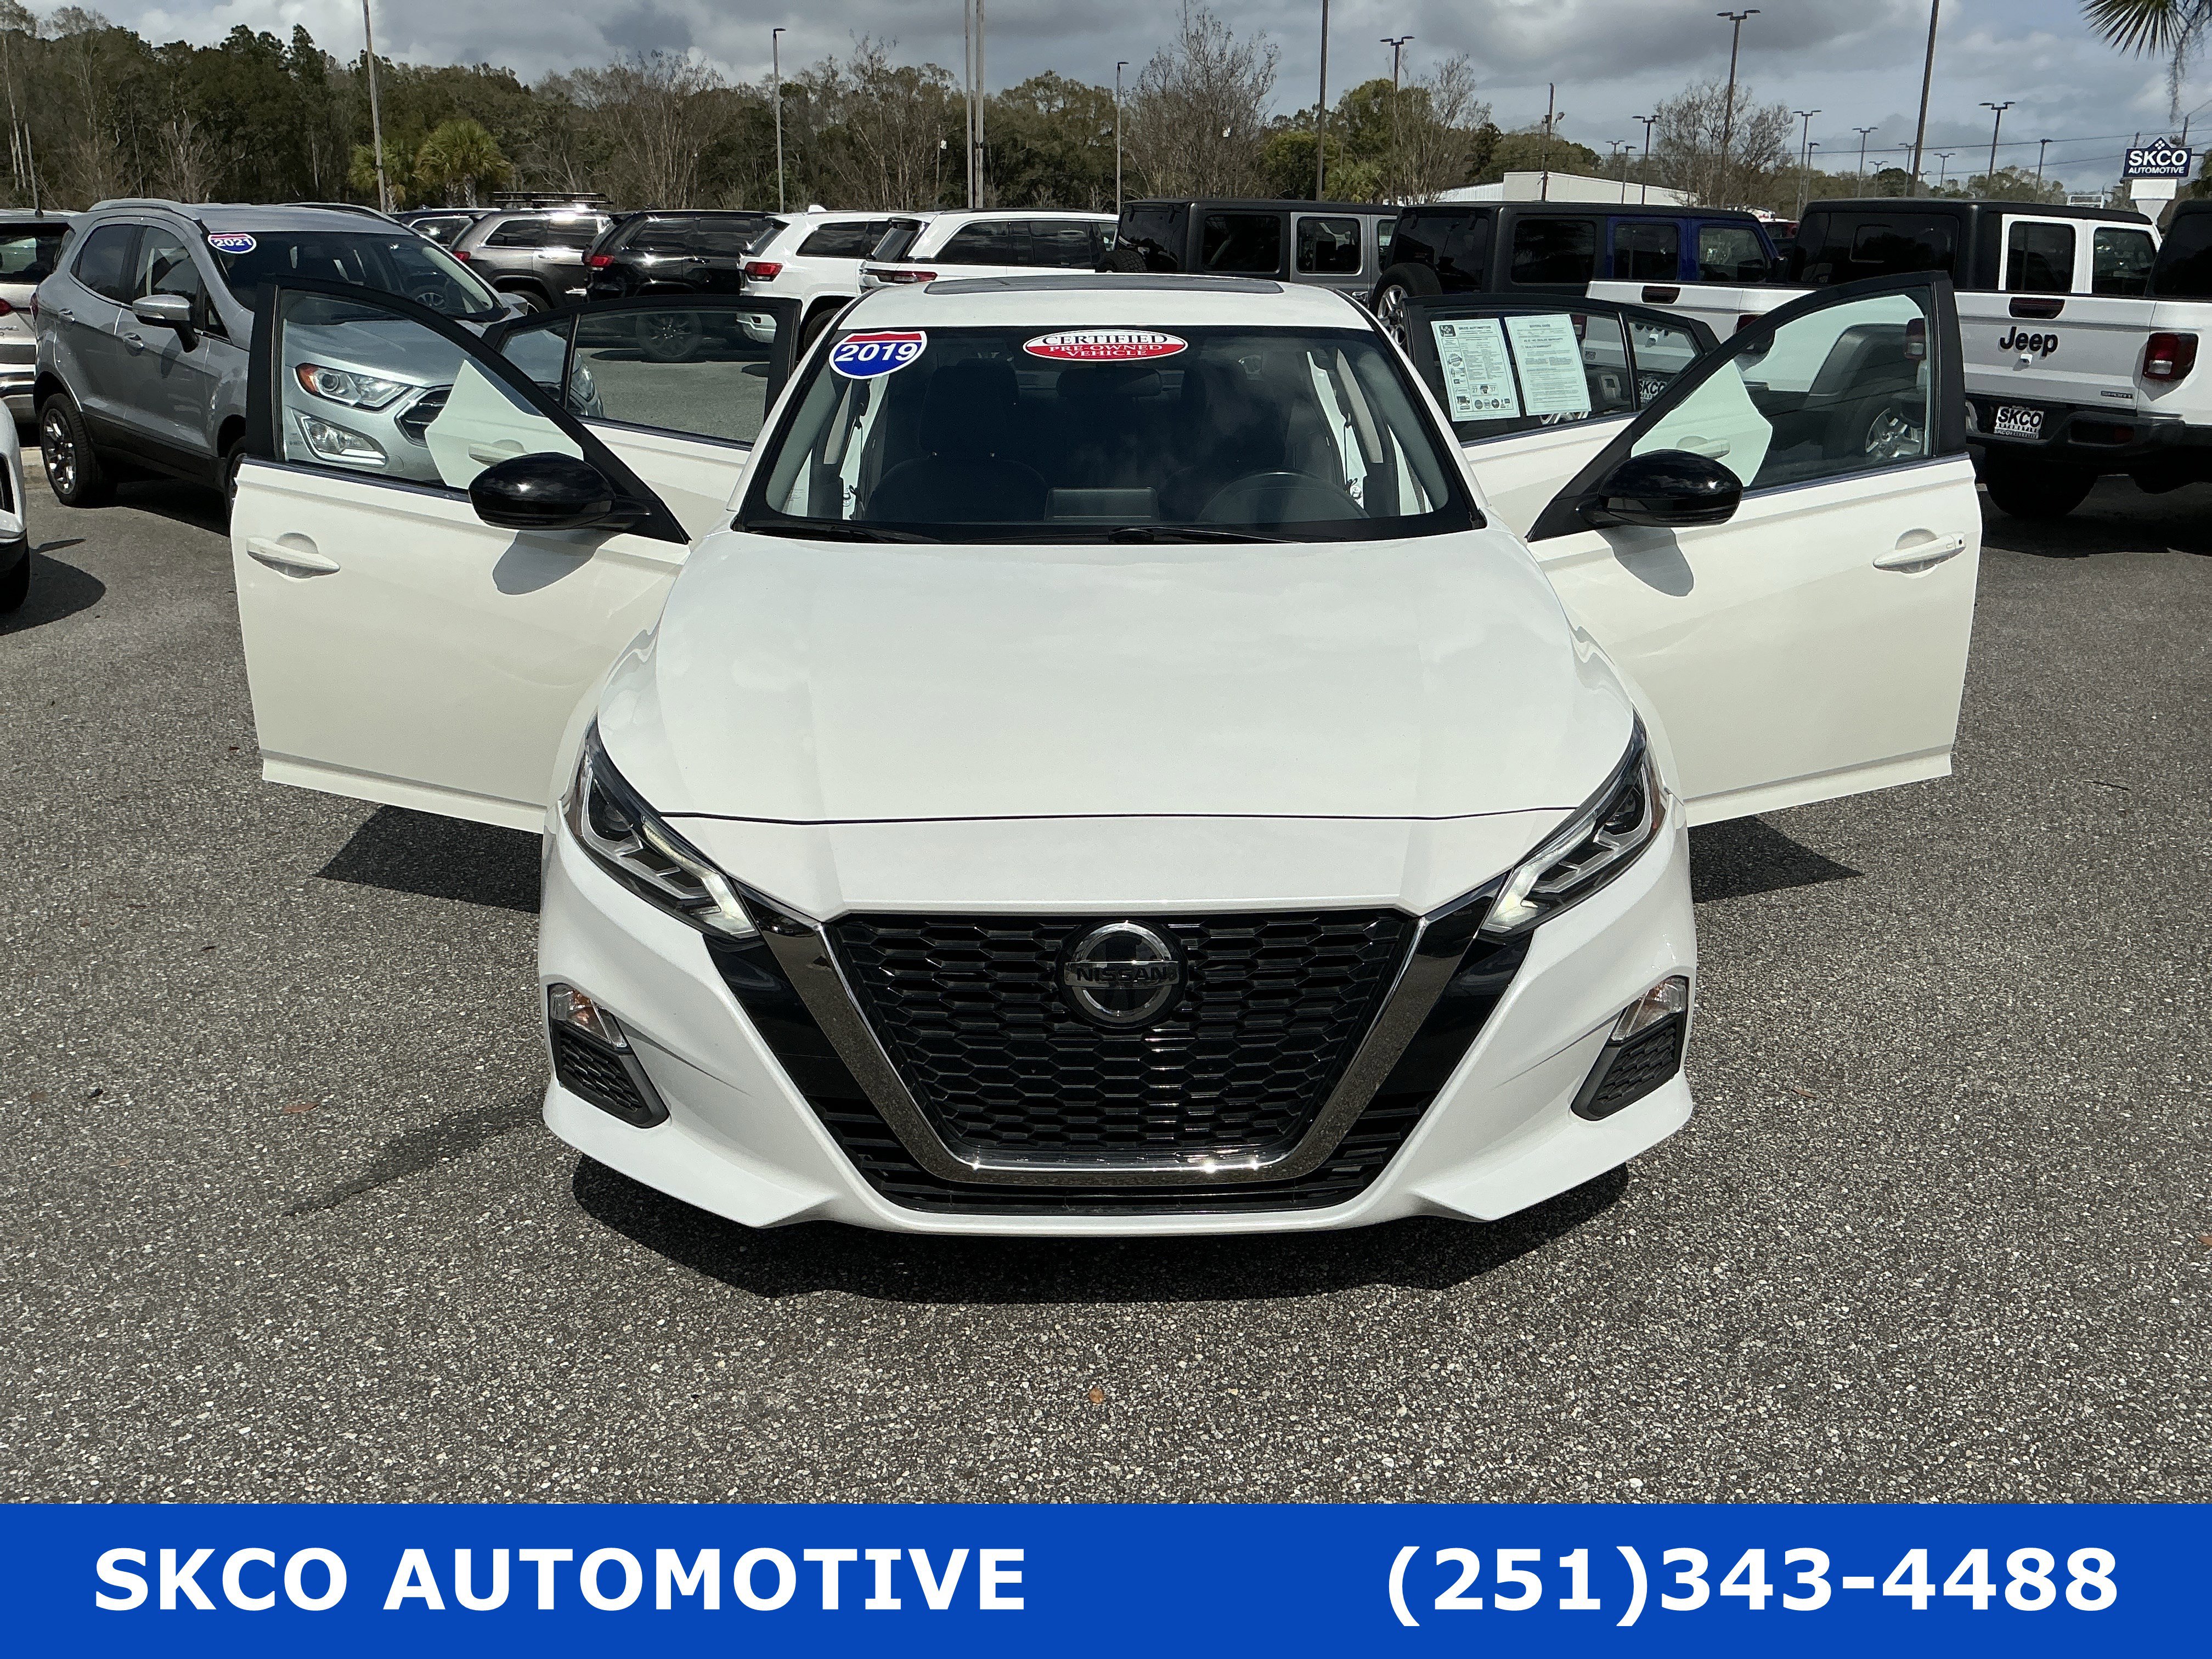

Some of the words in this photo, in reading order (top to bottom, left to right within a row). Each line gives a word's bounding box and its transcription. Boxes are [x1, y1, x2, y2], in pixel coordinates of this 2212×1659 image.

[2128, 150, 2187, 166] SKCO
[213, 238, 252, 247] 2021
[1042, 334, 1168, 345] CERTIFIED
[1999, 326, 2058, 357] Jeep
[834, 343, 918, 362] 2019
[1998, 408, 2042, 427] SKCO
[1076, 966, 1167, 982] NISSAN
